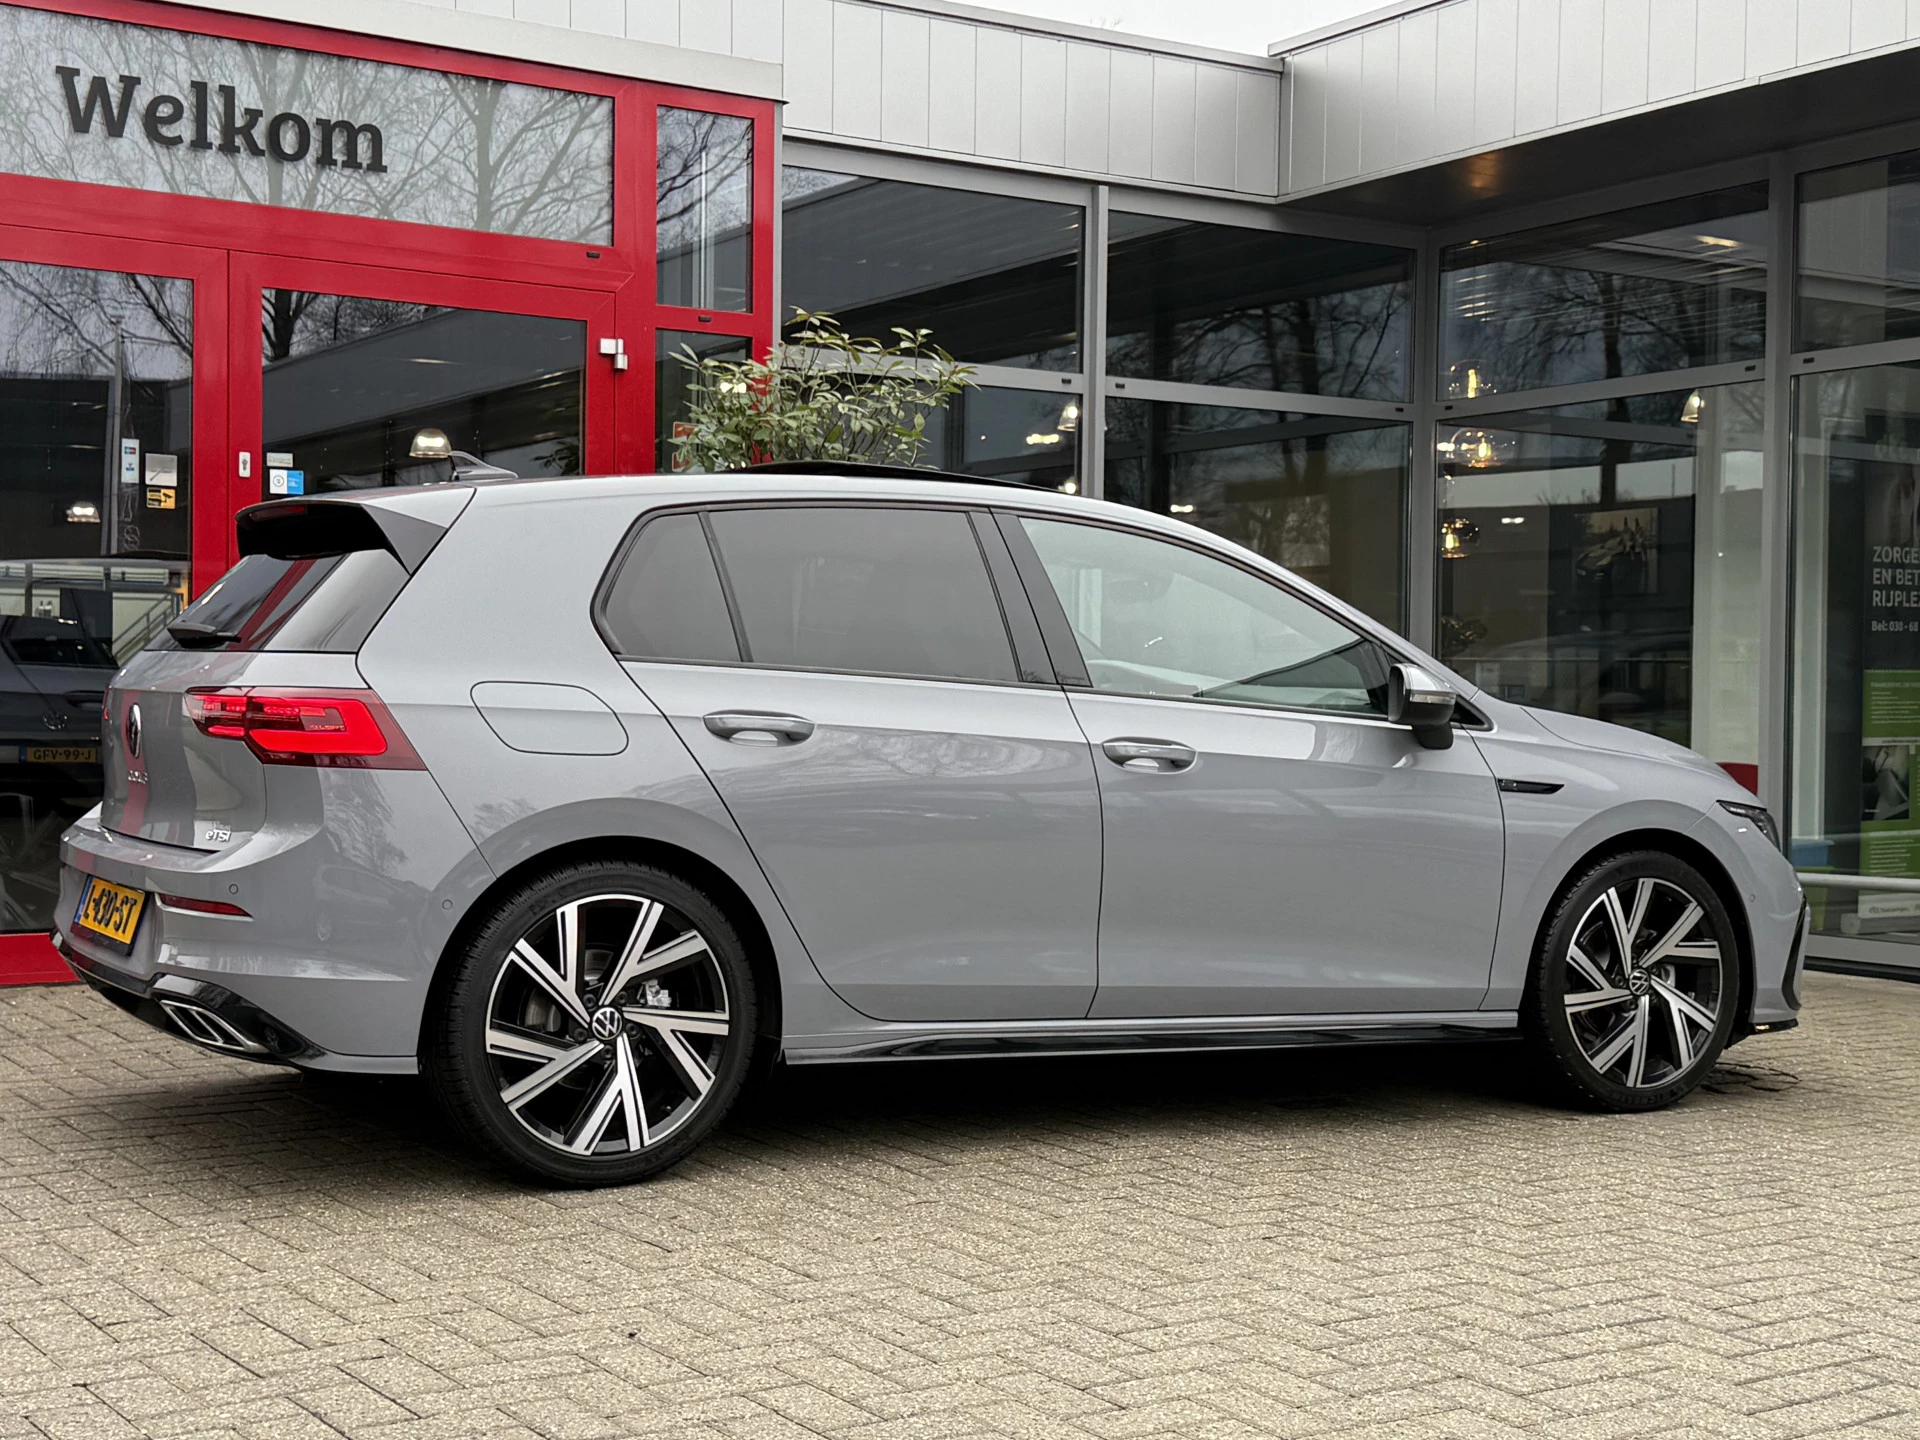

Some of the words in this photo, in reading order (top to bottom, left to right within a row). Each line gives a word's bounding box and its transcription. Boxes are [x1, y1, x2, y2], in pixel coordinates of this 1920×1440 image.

[56, 65, 388, 173] Welkom
[1873, 546, 1920, 564] ZORGE
[1873, 568, 1892, 585] EN
[1872, 589, 1920, 608] RIJPLE
